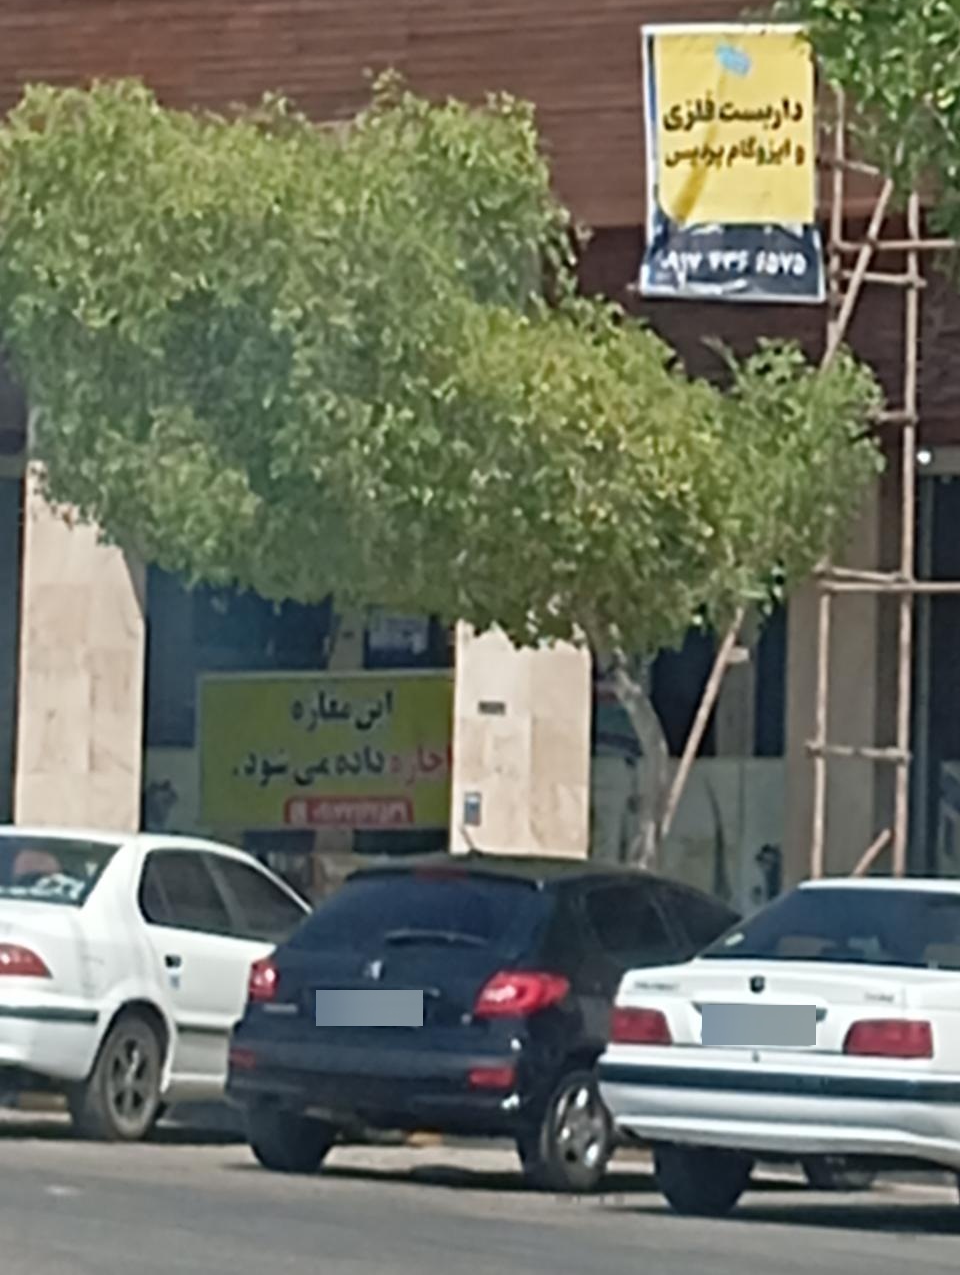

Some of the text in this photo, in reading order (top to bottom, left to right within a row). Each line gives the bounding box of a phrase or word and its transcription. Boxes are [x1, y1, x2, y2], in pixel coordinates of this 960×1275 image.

[662, 90, 804, 132] داربست فلزی
[726, 135, 792, 167] ایزوگام
[290, 689, 393, 732] این مغازه
[335, 744, 386, 778] داده
